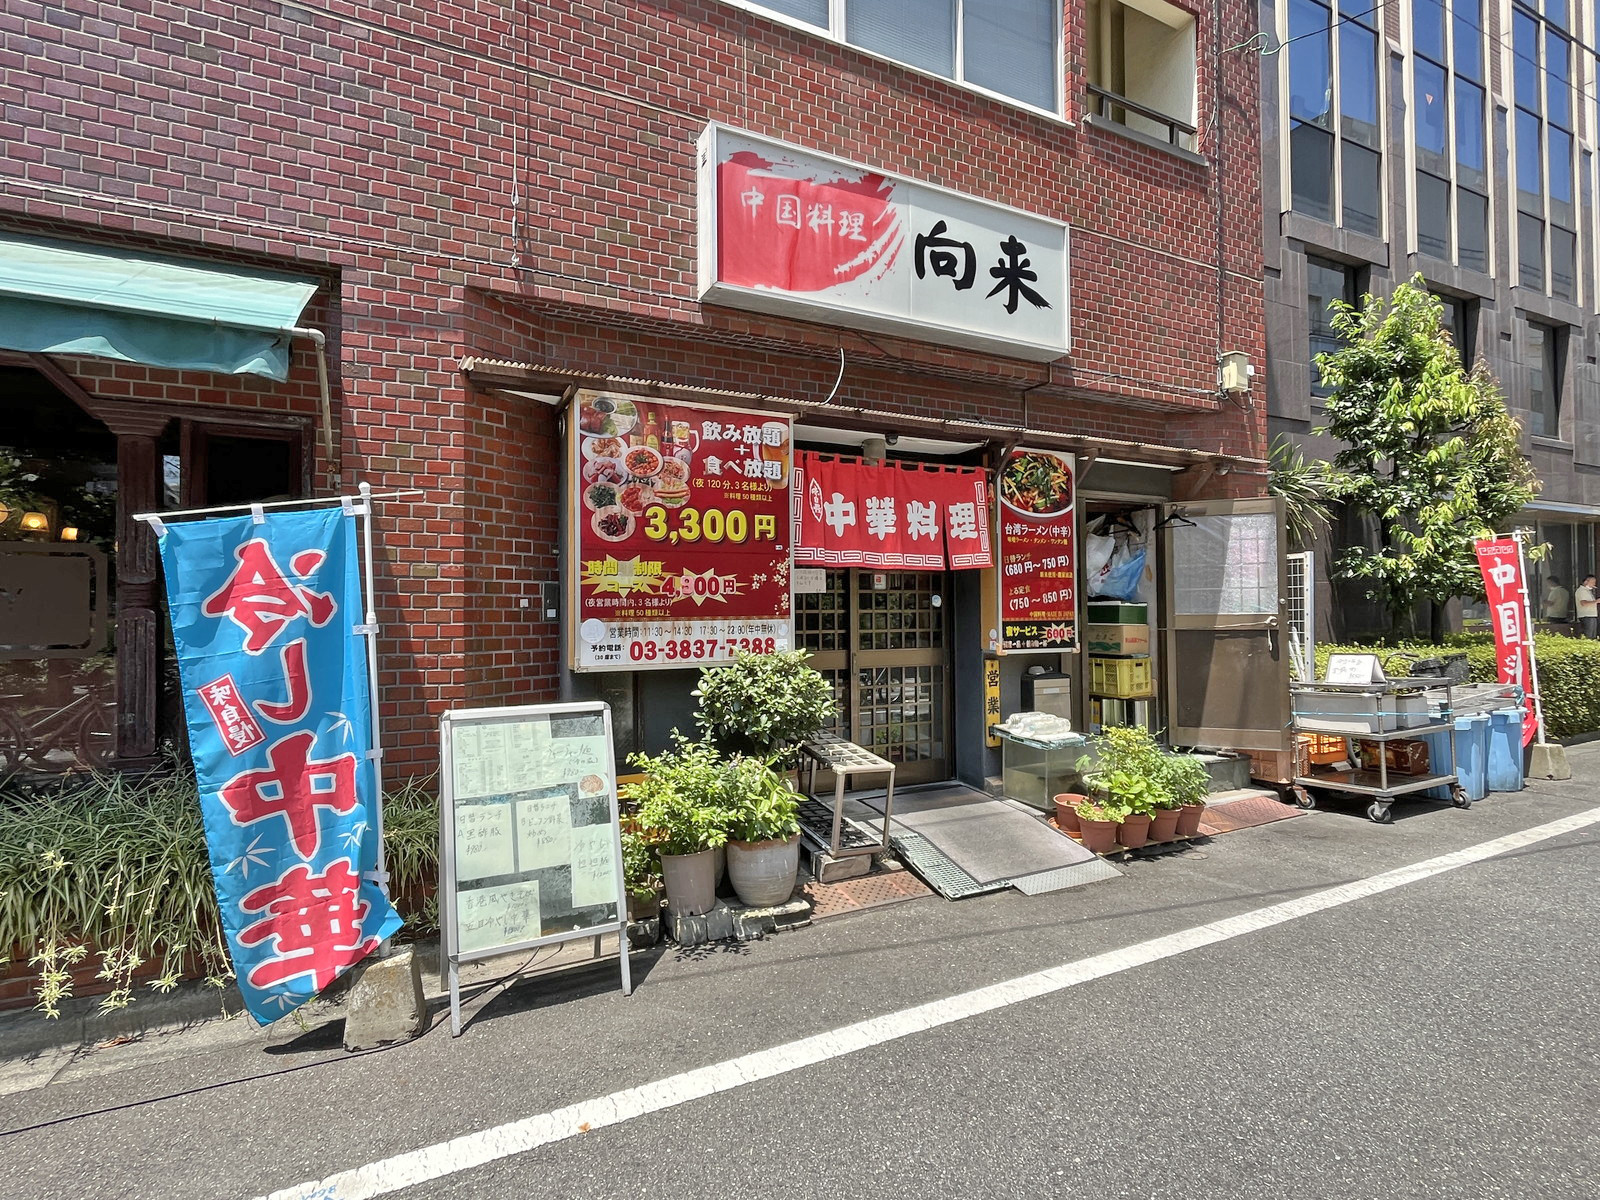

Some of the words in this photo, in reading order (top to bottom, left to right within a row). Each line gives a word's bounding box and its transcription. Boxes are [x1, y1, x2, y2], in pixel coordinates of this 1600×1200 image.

[740, 185, 867, 242] 中国料理
[914, 219, 1053, 315] 向来
[701, 420, 782, 447] 飲み放題
[702, 455, 783, 480] 食べ放題
[823, 492, 979, 542] 中華料理
[1004, 522, 1071, 538] 台湾ラーメン(中辛)
[606, 580, 646, 593] コース
